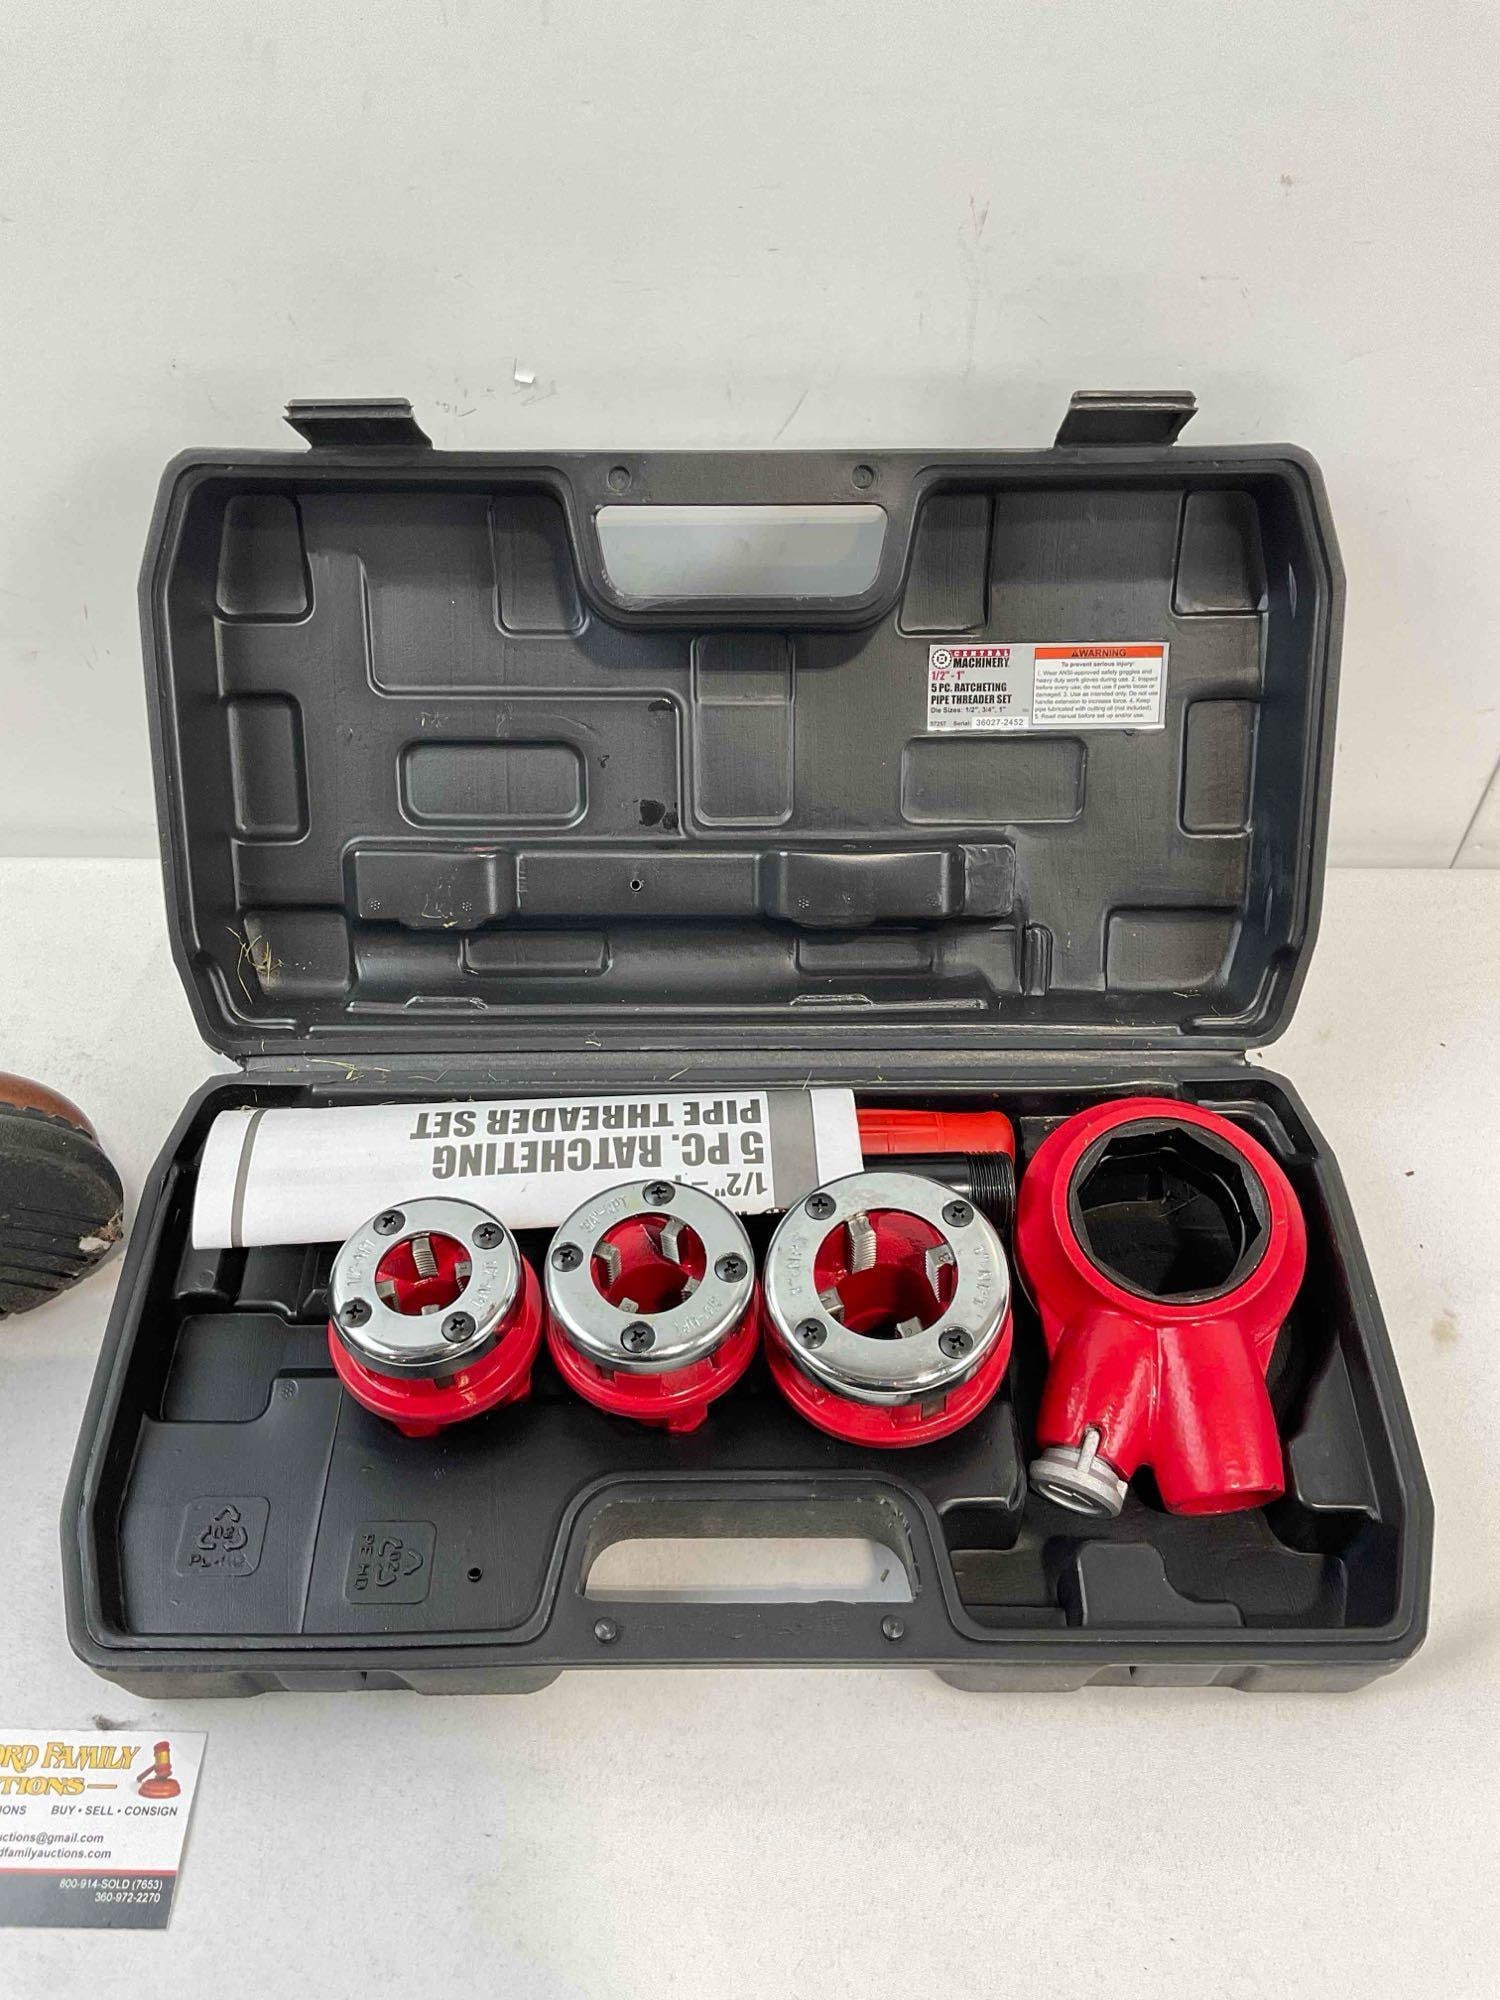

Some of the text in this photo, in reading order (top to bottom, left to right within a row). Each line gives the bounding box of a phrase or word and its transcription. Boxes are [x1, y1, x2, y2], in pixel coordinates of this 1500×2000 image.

[1080, 648, 1127, 657] WARNING
[953, 657, 1009, 668] MACHINERY
[931, 670, 950, 680] 1/2"
[957, 670, 965, 680] 1"
[931, 682, 1007, 692] 5 PC. RATCHETING
[931, 694, 1012, 705] PIPE THREADER SET
[975, 718, 1024, 727] 36027-2452
[409, 1099, 761, 1140] PIPE THREADER SET
[432, 1131, 765, 1179] 5 PC. RATCHETING
[714, 1172, 767, 1196] 1/2"
[41, 1741, 141, 1771] FAMILY
[51, 1805, 75, 1815] BUY
[85, 1805, 114, 1816] SELL
[124, 1806, 178, 1817] CONSIGN
[59, 1878, 163, 1890] 800-914-SOLD (7653)
[95, 1892, 160, 1903] 360-972-2270
